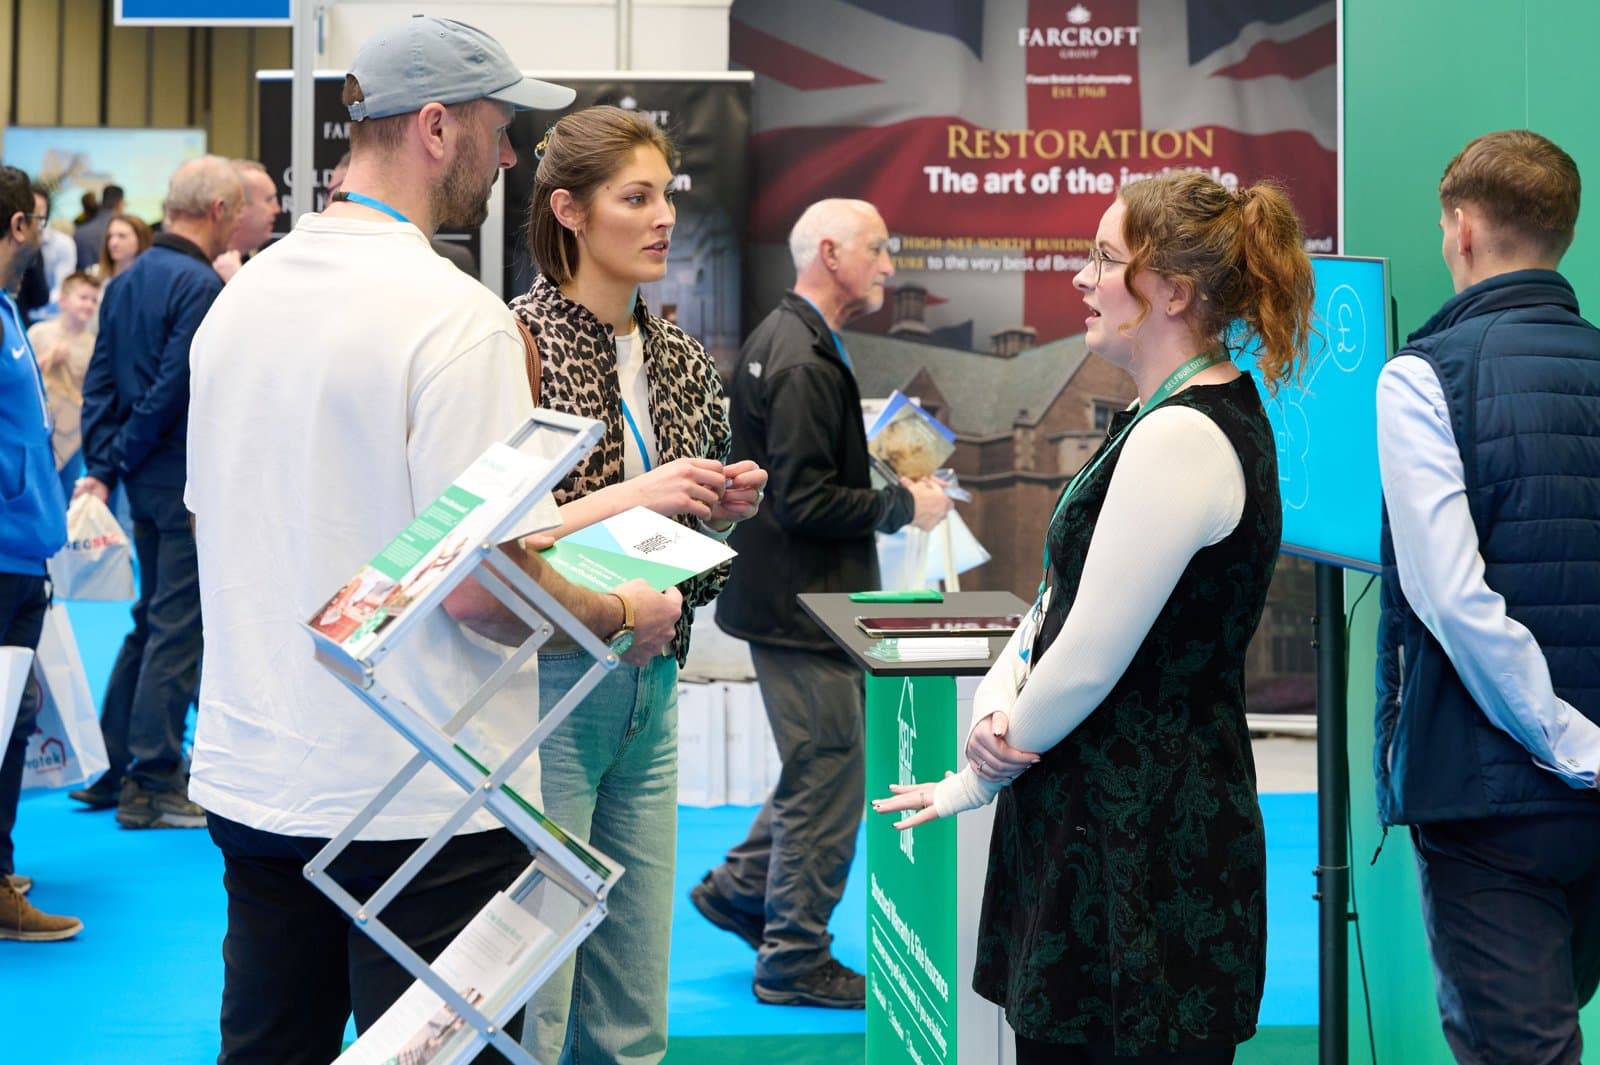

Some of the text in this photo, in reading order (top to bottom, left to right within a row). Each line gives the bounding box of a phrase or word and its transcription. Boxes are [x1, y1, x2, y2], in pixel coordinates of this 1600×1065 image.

[1018, 27, 1141, 47] FARCROFT
[923, 166, 977, 194] The
[984, 168, 1026, 194] art
[1030, 166, 1062, 194] of
[1066, 167, 1114, 194] the
[1304, 236, 1333, 252] and
[927, 255, 943, 271] to
[945, 255, 968, 271] the
[970, 258, 1000, 273] very
[1003, 255, 1034, 271] best
[1036, 255, 1051, 271] of
